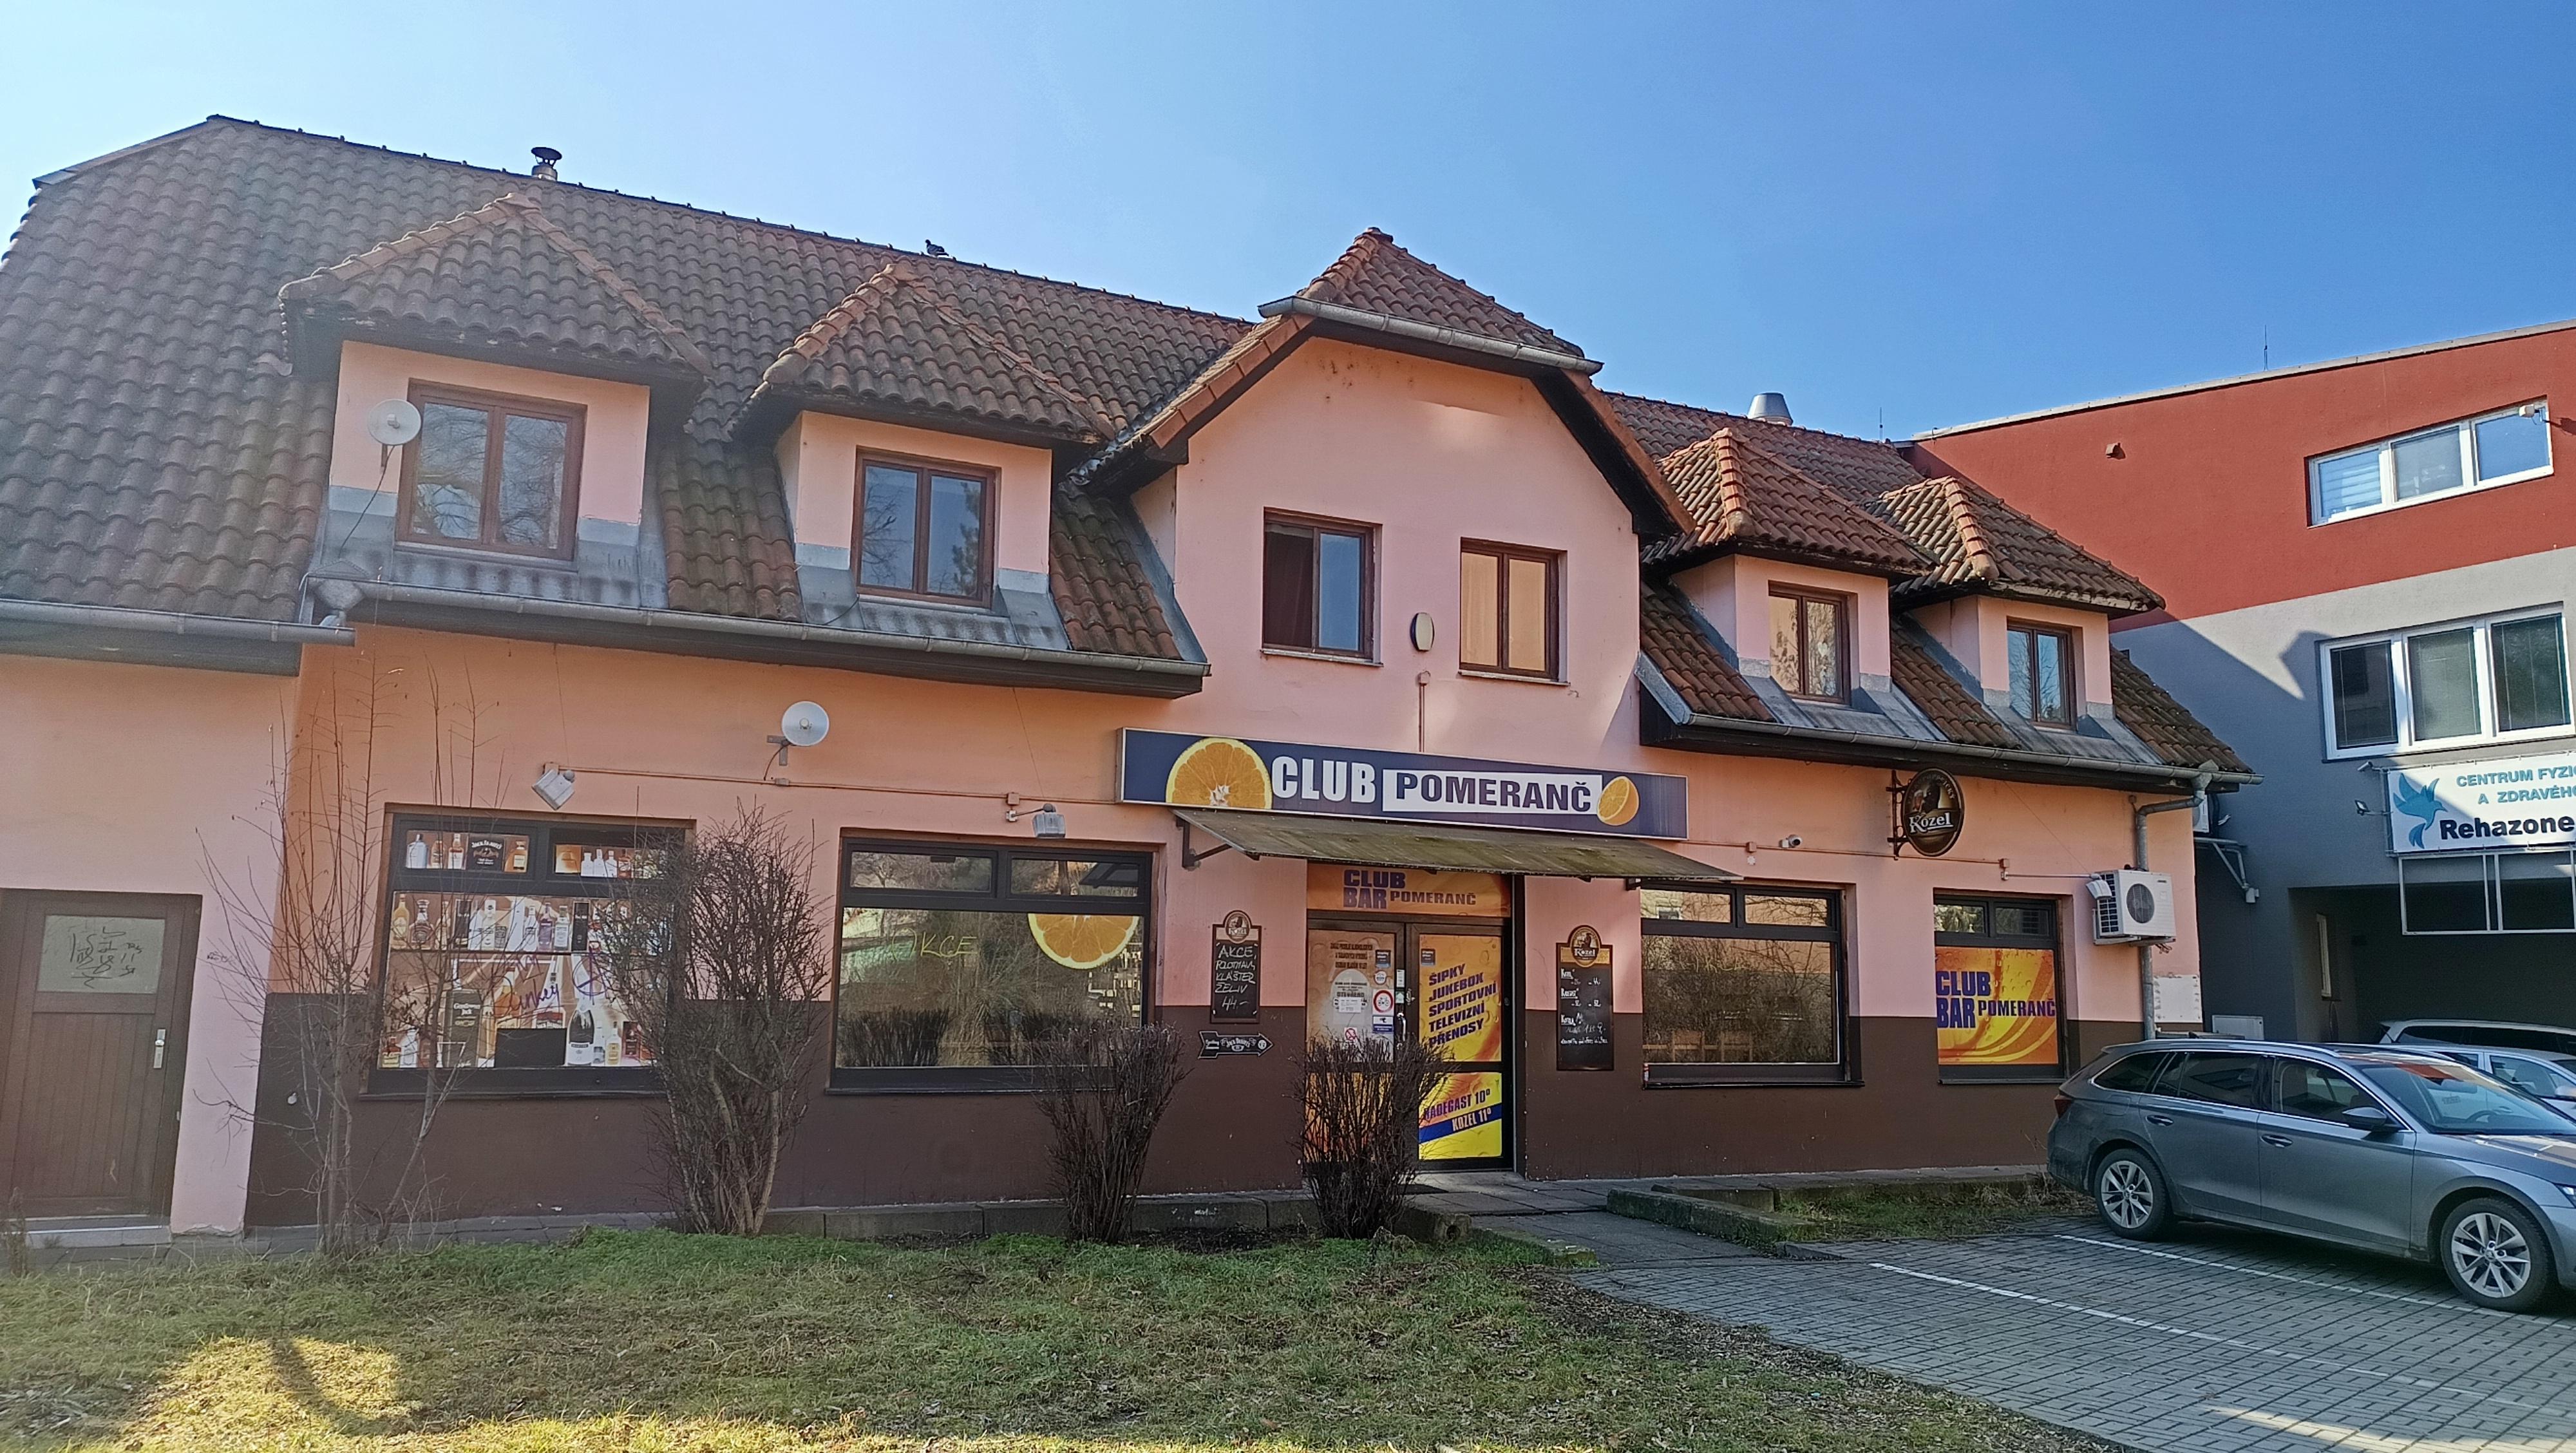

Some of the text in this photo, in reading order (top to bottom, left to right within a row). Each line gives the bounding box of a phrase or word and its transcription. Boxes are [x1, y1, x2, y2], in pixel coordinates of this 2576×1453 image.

[1272, 755, 1592, 813] CLUB POMERANČ
[2456, 765, 2576, 787] CENTRUM FYZI
[2477, 793, 2489, 804] A
[1909, 812, 1954, 833] Kozel
[2439, 816, 2575, 840] Rehazone
[1343, 869, 1406, 889] CLUB
[1343, 887, 1477, 909] BAR POMERANČ
[1573, 947, 1596, 957] Kozel
[1428, 963, 1466, 986] ŠIPKY
[1936, 971, 1991, 997] CLUB
[1428, 971, 1484, 1002] JUKEBOX
[1428, 980, 1497, 1017] SPORTOVNÍ
[1428, 1000, 1485, 1033] TELEVIZNÍ
[1937, 998, 2056, 1029] BAR POMERANČ
[1428, 1018, 1484, 1048] PŘENOSY
[1451, 1112, 1477, 1132] KOZEL
